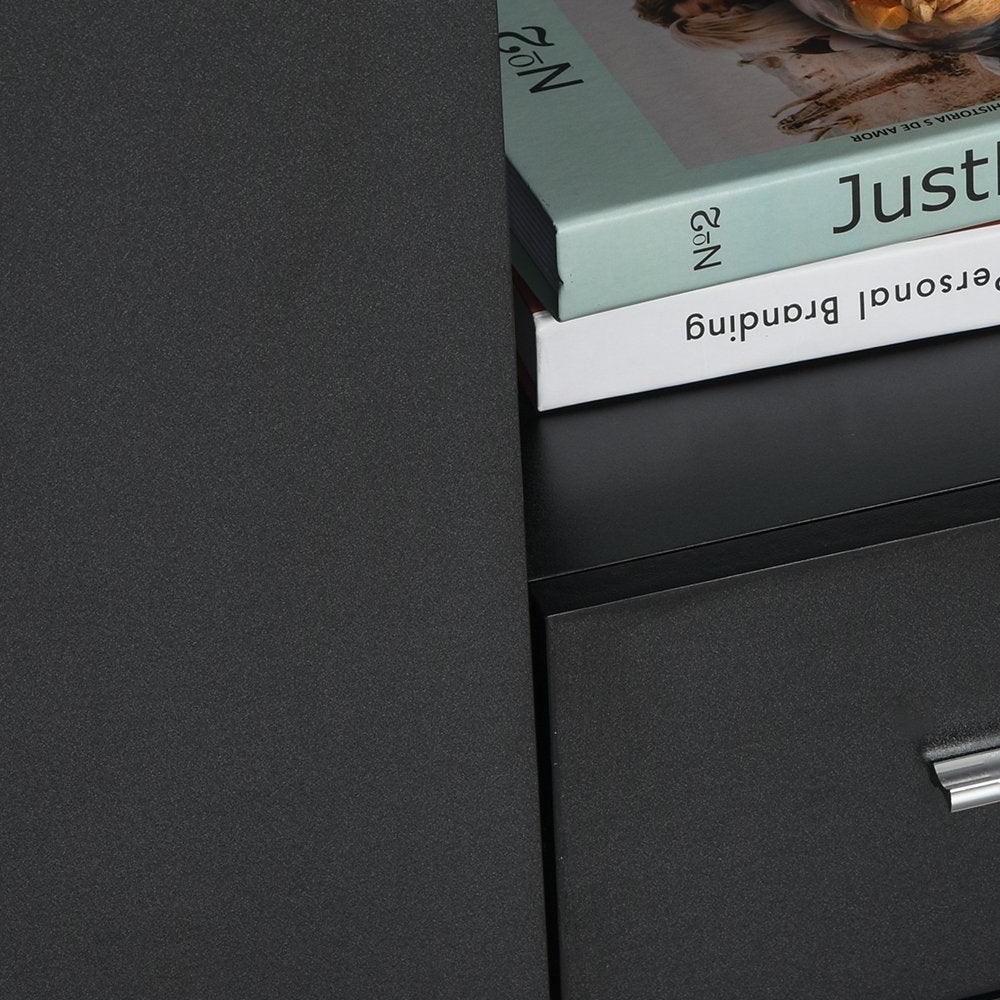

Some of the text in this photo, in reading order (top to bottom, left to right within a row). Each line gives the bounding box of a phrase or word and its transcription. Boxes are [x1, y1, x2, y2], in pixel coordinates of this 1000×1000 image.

[850, 125, 897, 143] AMOR
[903, 121, 922, 132] DE
[685, 296, 840, 342] Branding
